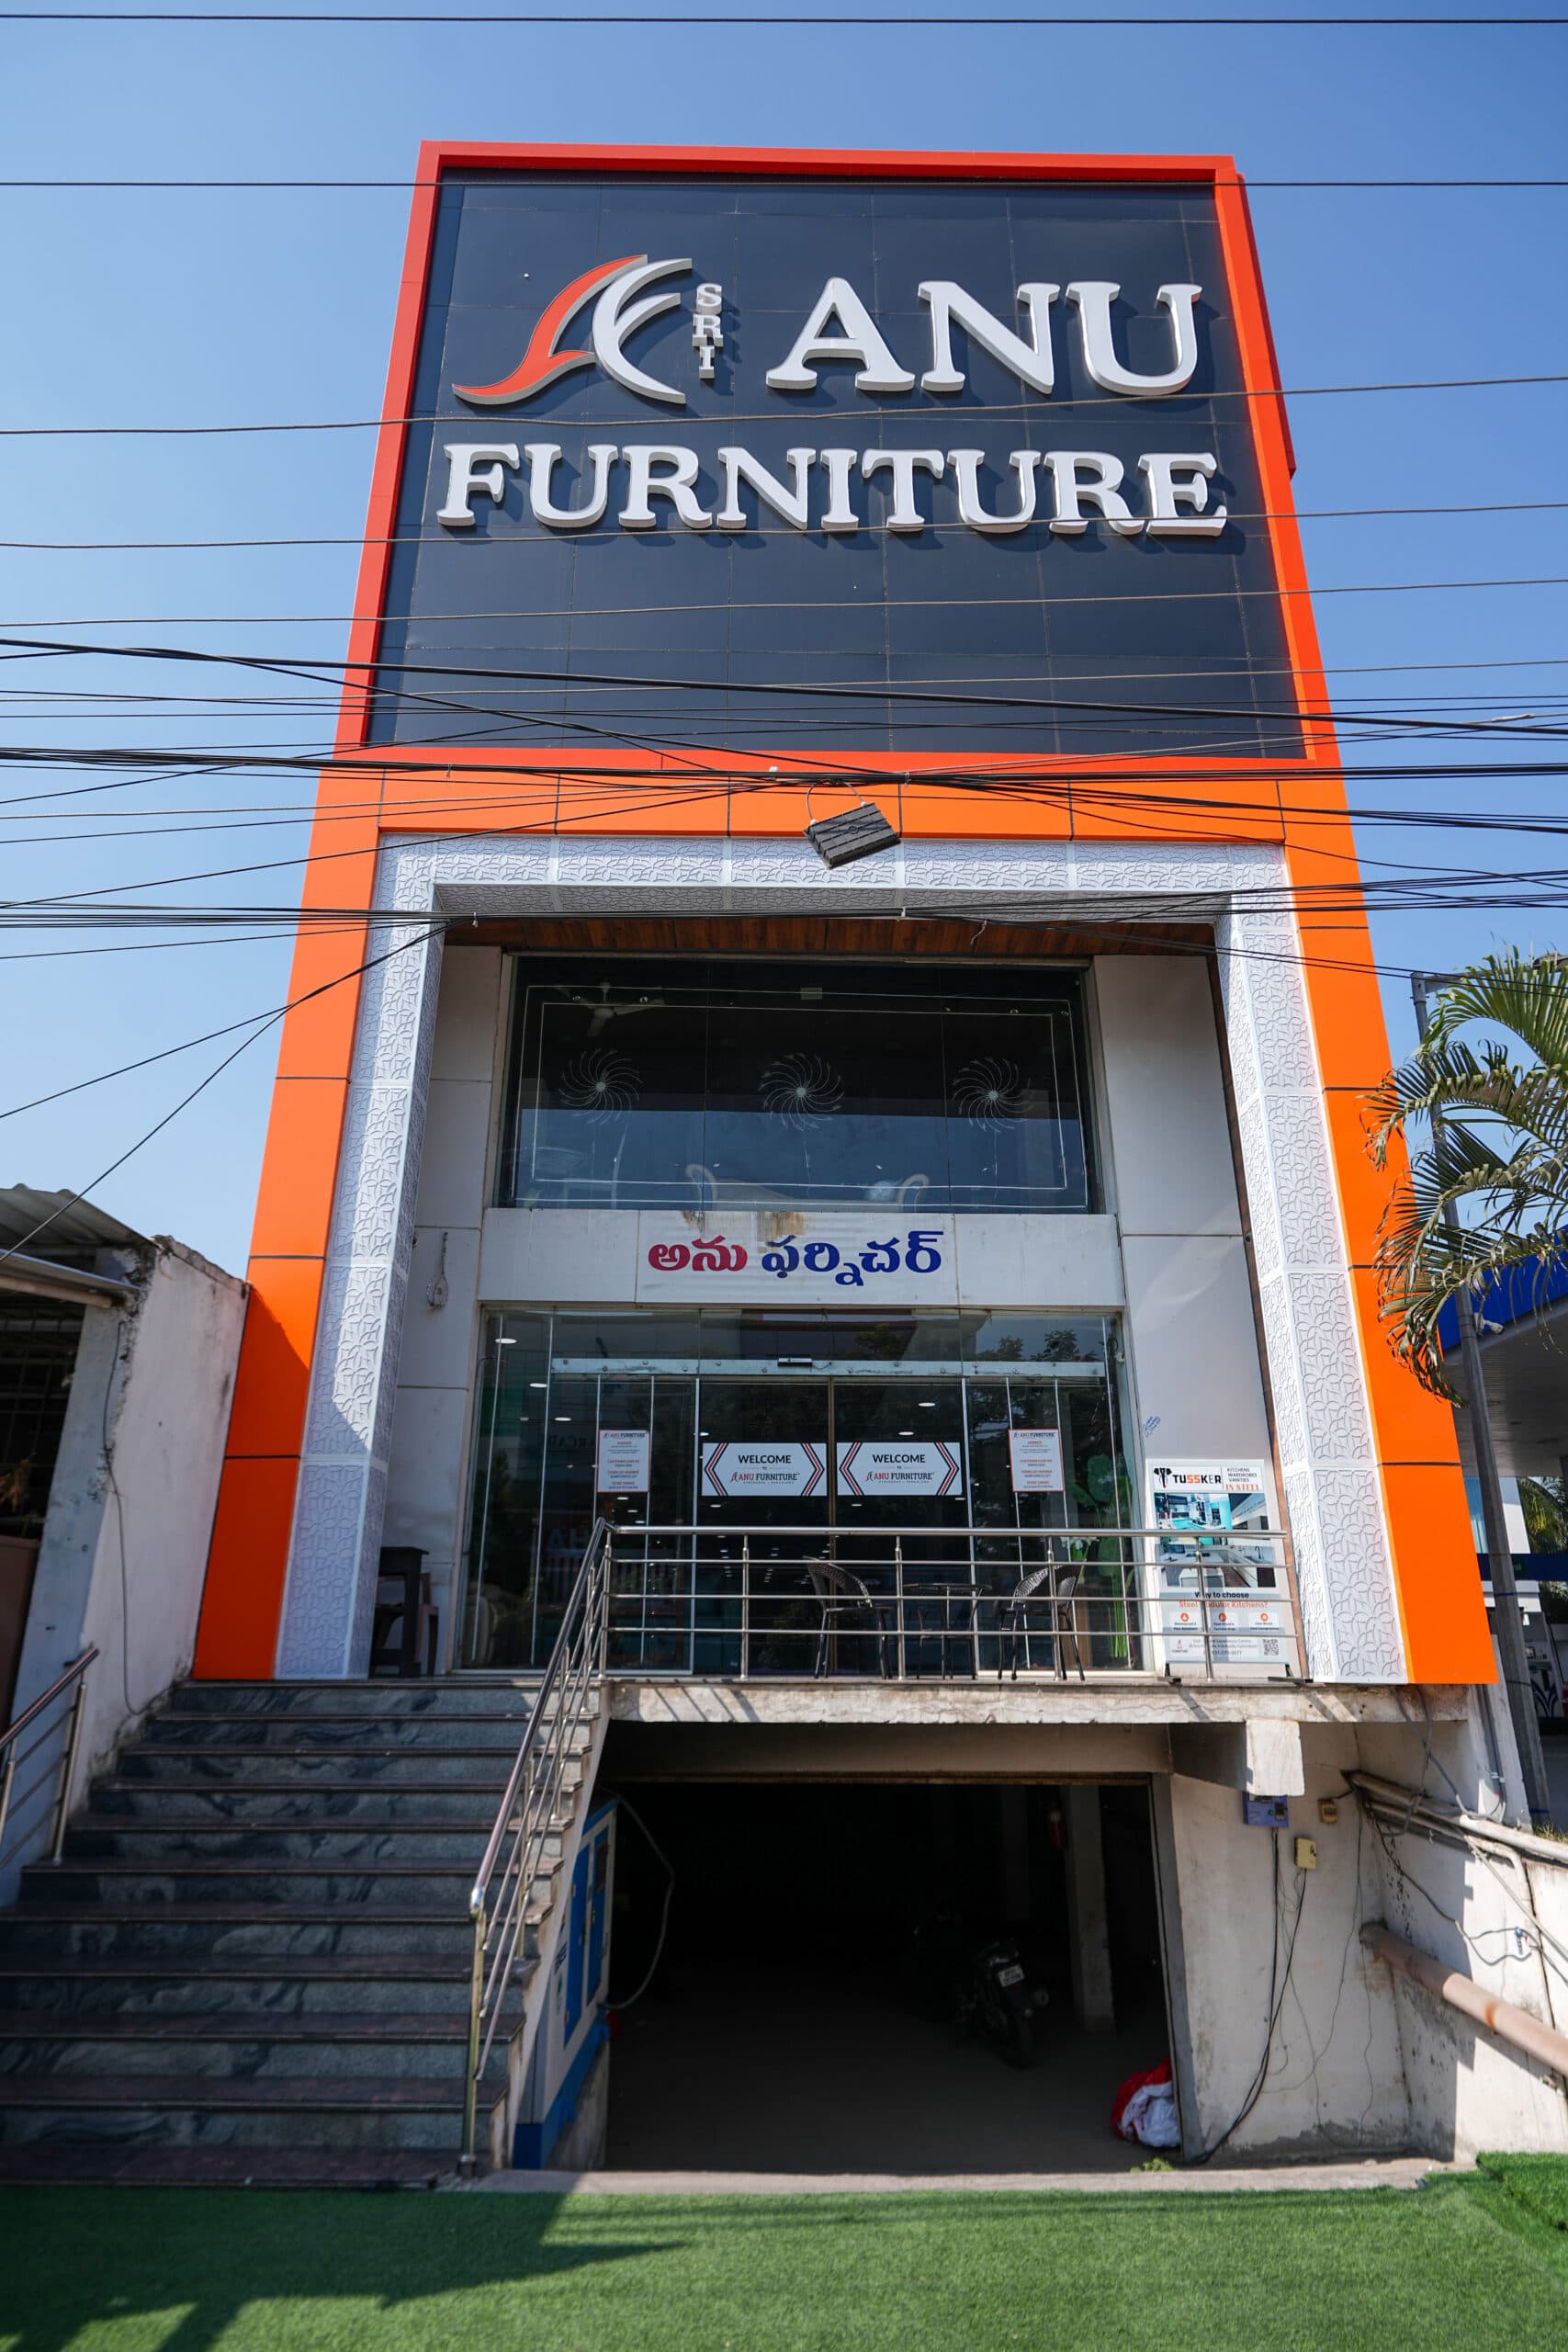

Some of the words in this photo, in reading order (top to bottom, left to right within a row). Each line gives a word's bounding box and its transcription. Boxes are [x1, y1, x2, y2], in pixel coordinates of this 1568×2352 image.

[692, 283, 725, 379] SRI
[766, 277, 1202, 396] ANU
[435, 443, 1228, 537] FURNITURE
[648, 1234, 748, 1272] అను
[761, 1230, 944, 1286] ఫర్నిచర్
[738, 1454, 791, 1464] WELCOME
[872, 1453, 926, 1464] WELCOME
[739, 1473, 754, 1481] ANU
[756, 1473, 797, 1481] FURNITURE
[874, 1472, 889, 1480] ANU
[890, 1472, 932, 1480] FURNITURE
[1172, 1474, 1222, 1485] TUSSKER
